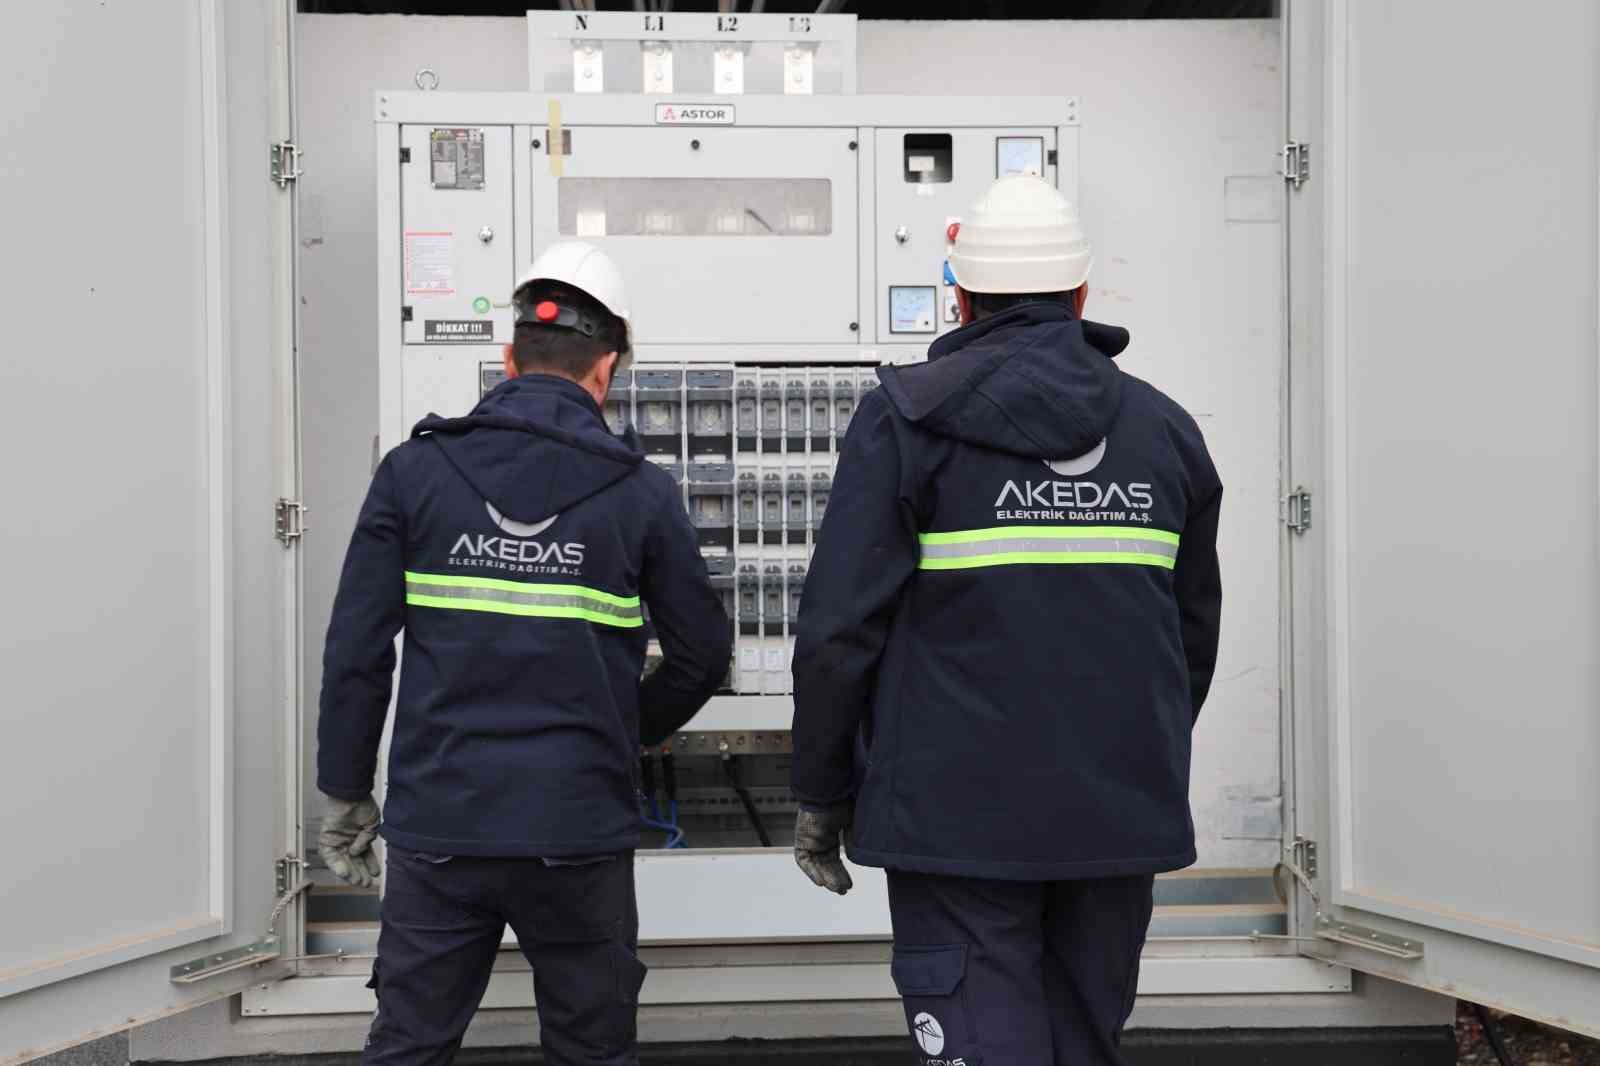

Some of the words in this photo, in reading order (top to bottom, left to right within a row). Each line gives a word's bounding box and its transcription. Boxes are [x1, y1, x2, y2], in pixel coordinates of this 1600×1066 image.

[576, 15, 588, 30] N
[644, 15, 665, 31] L1
[717, 16, 738, 32] L2
[788, 17, 811, 32] L3
[681, 110, 726, 119] ASTOR
[436, 321, 469, 333] DİKKAT
[994, 479, 1153, 509] AKEDAS
[996, 508, 1065, 520] ELEKTRİK
[1069, 508, 1126, 521] DAĞITIM
[1129, 512, 1152, 524] A.Ş.
[449, 533, 585, 565] AKEDAS
